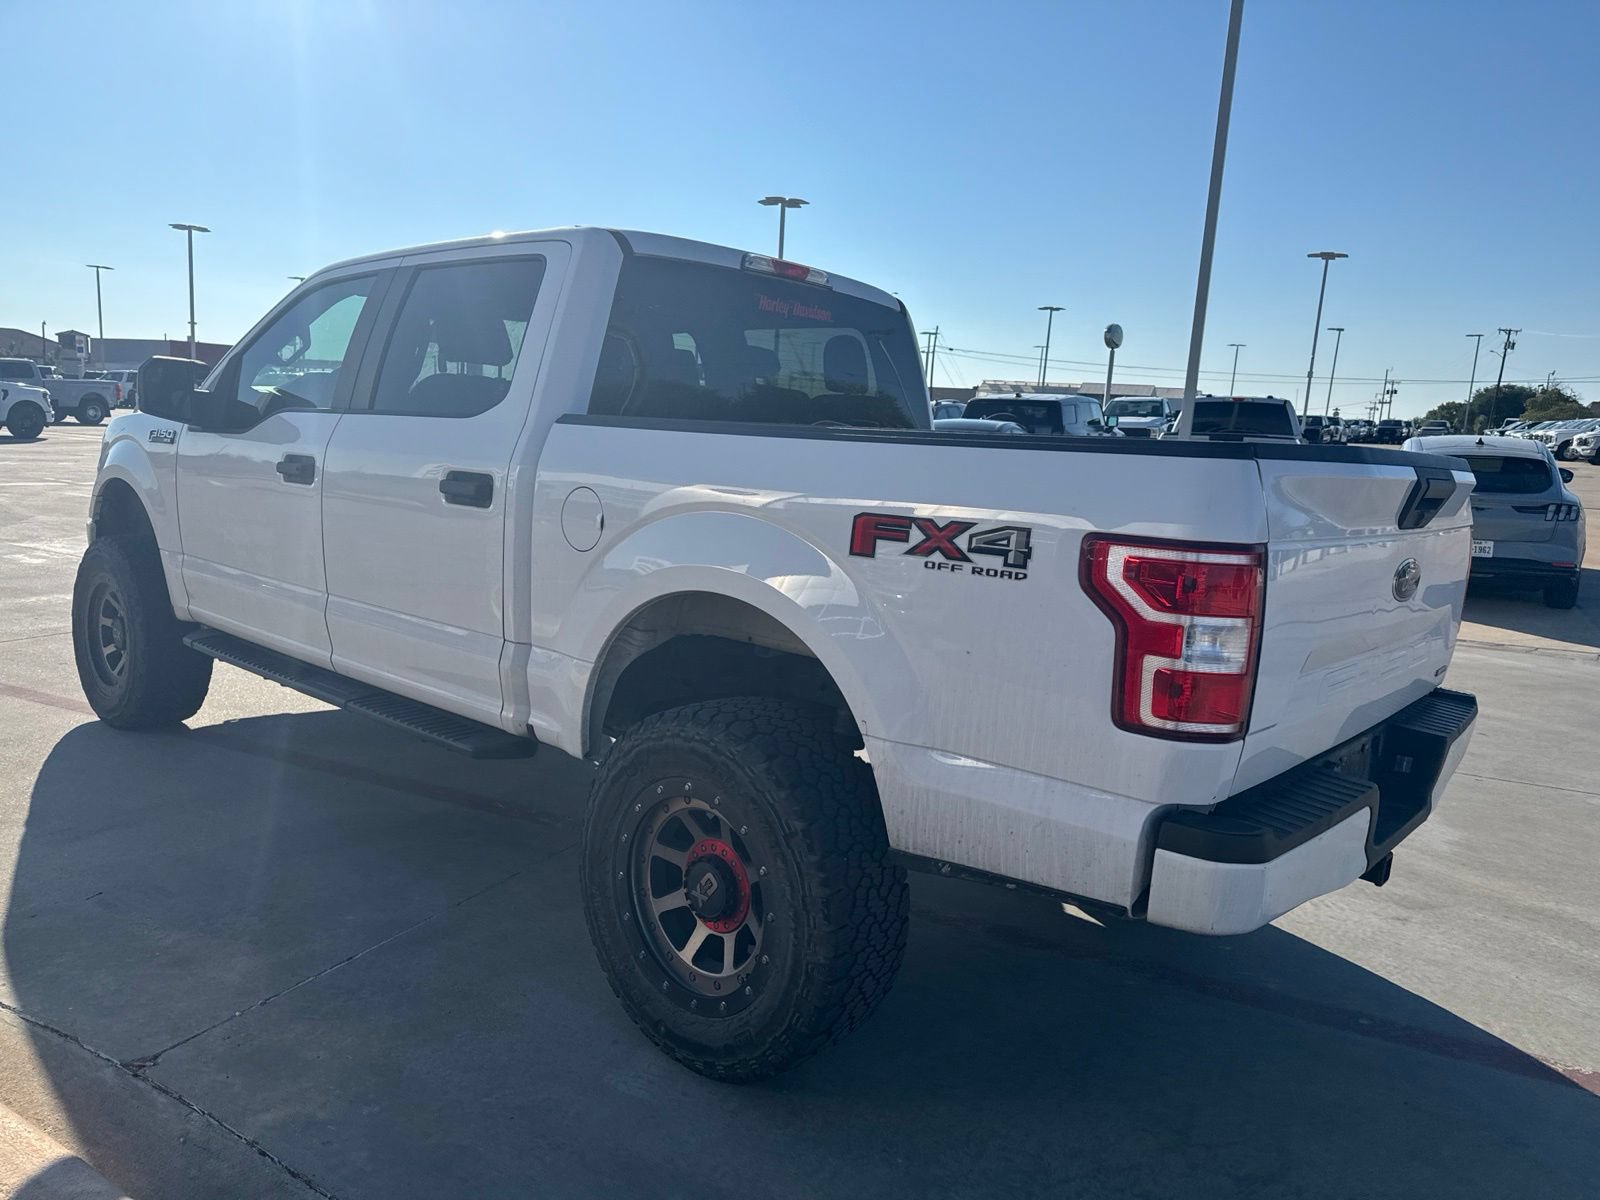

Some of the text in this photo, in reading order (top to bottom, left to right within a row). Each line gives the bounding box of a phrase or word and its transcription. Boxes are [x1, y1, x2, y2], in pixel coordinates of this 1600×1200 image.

[848, 511, 1033, 570] FX4
[924, 560, 1028, 581] OFF ROAD
